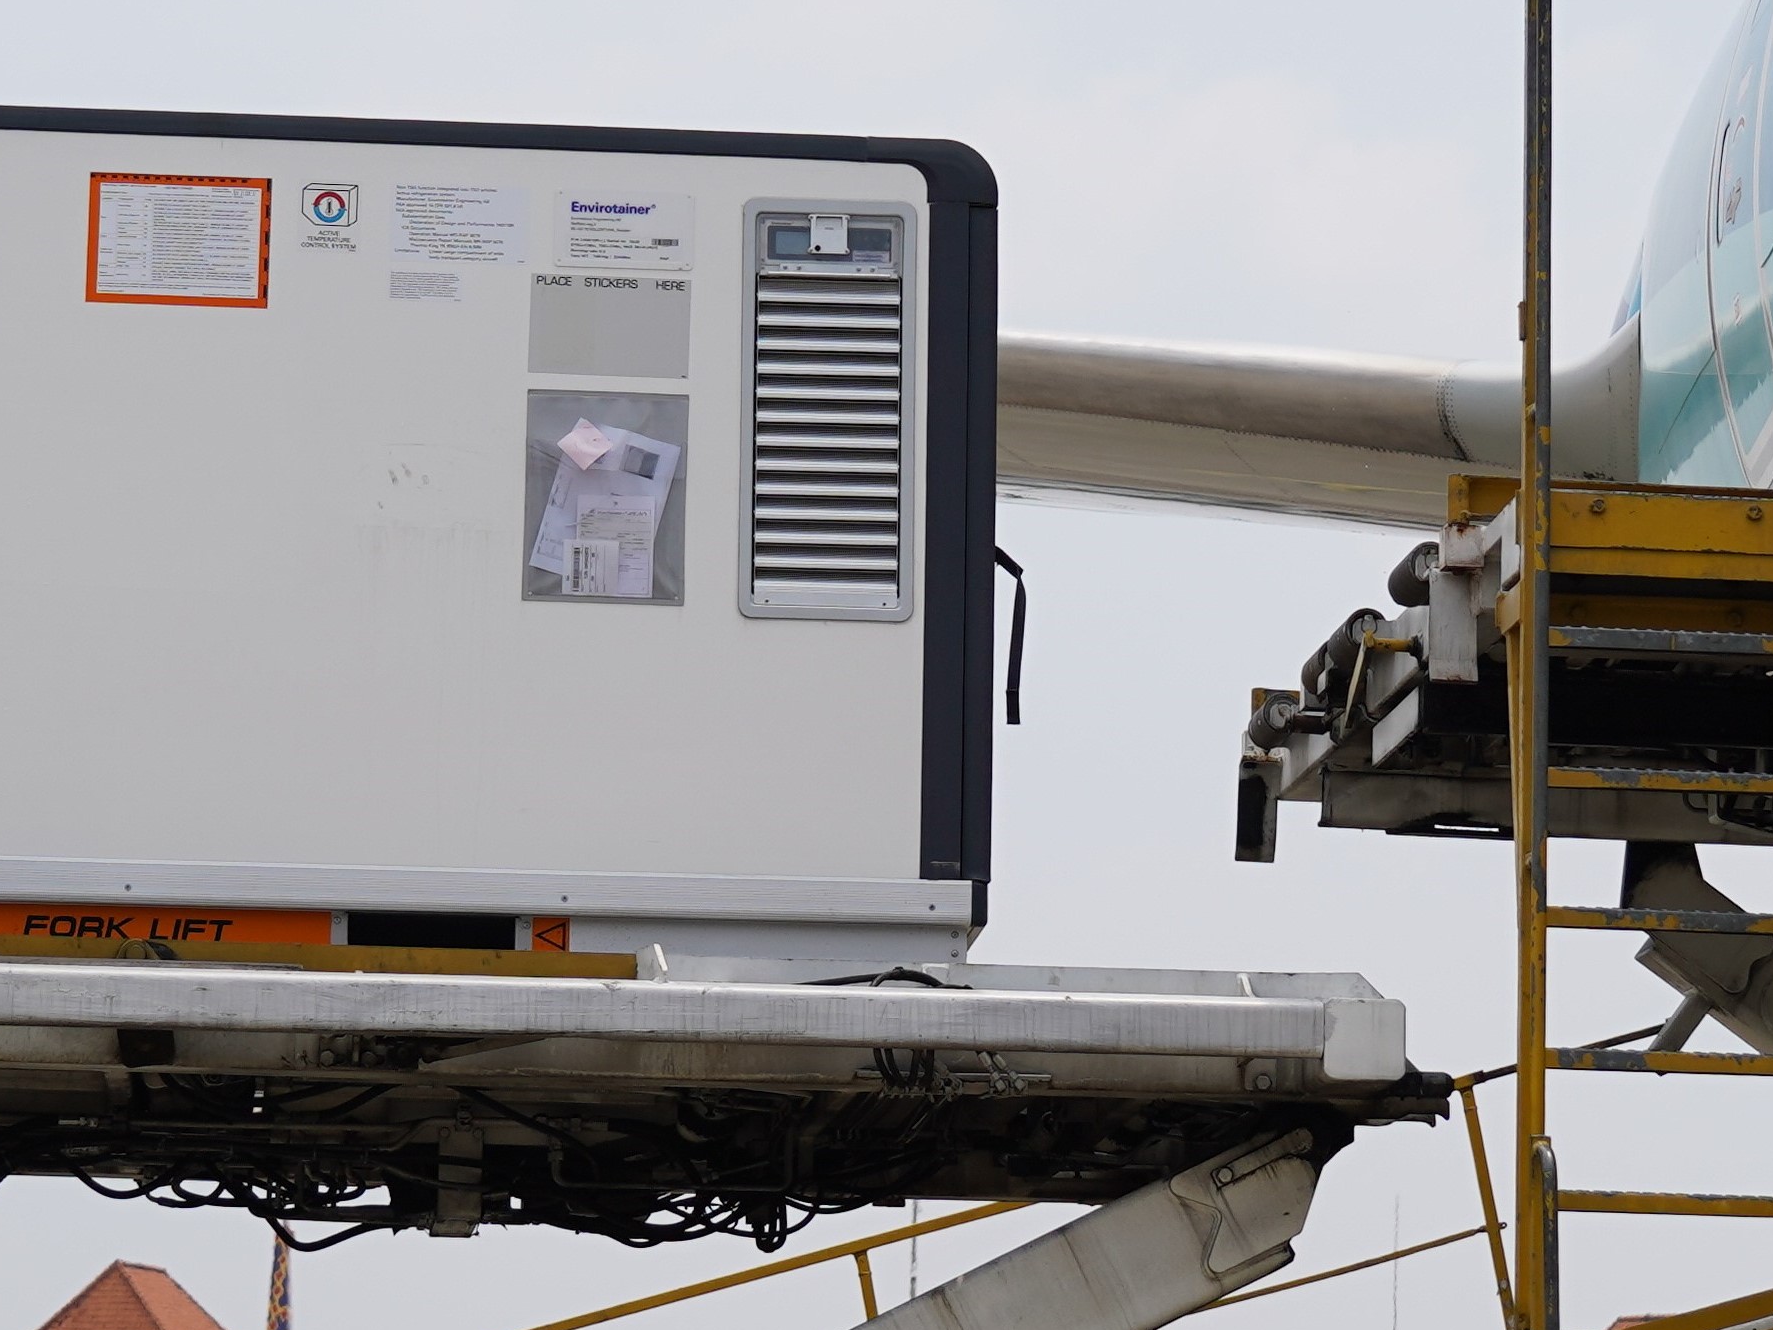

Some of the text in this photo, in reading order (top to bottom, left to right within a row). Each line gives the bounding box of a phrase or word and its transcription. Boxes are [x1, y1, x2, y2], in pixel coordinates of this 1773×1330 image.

[536, 275, 686, 291] PLACE STICKERS HERE
[23, 915, 233, 941] FORK LIFT
